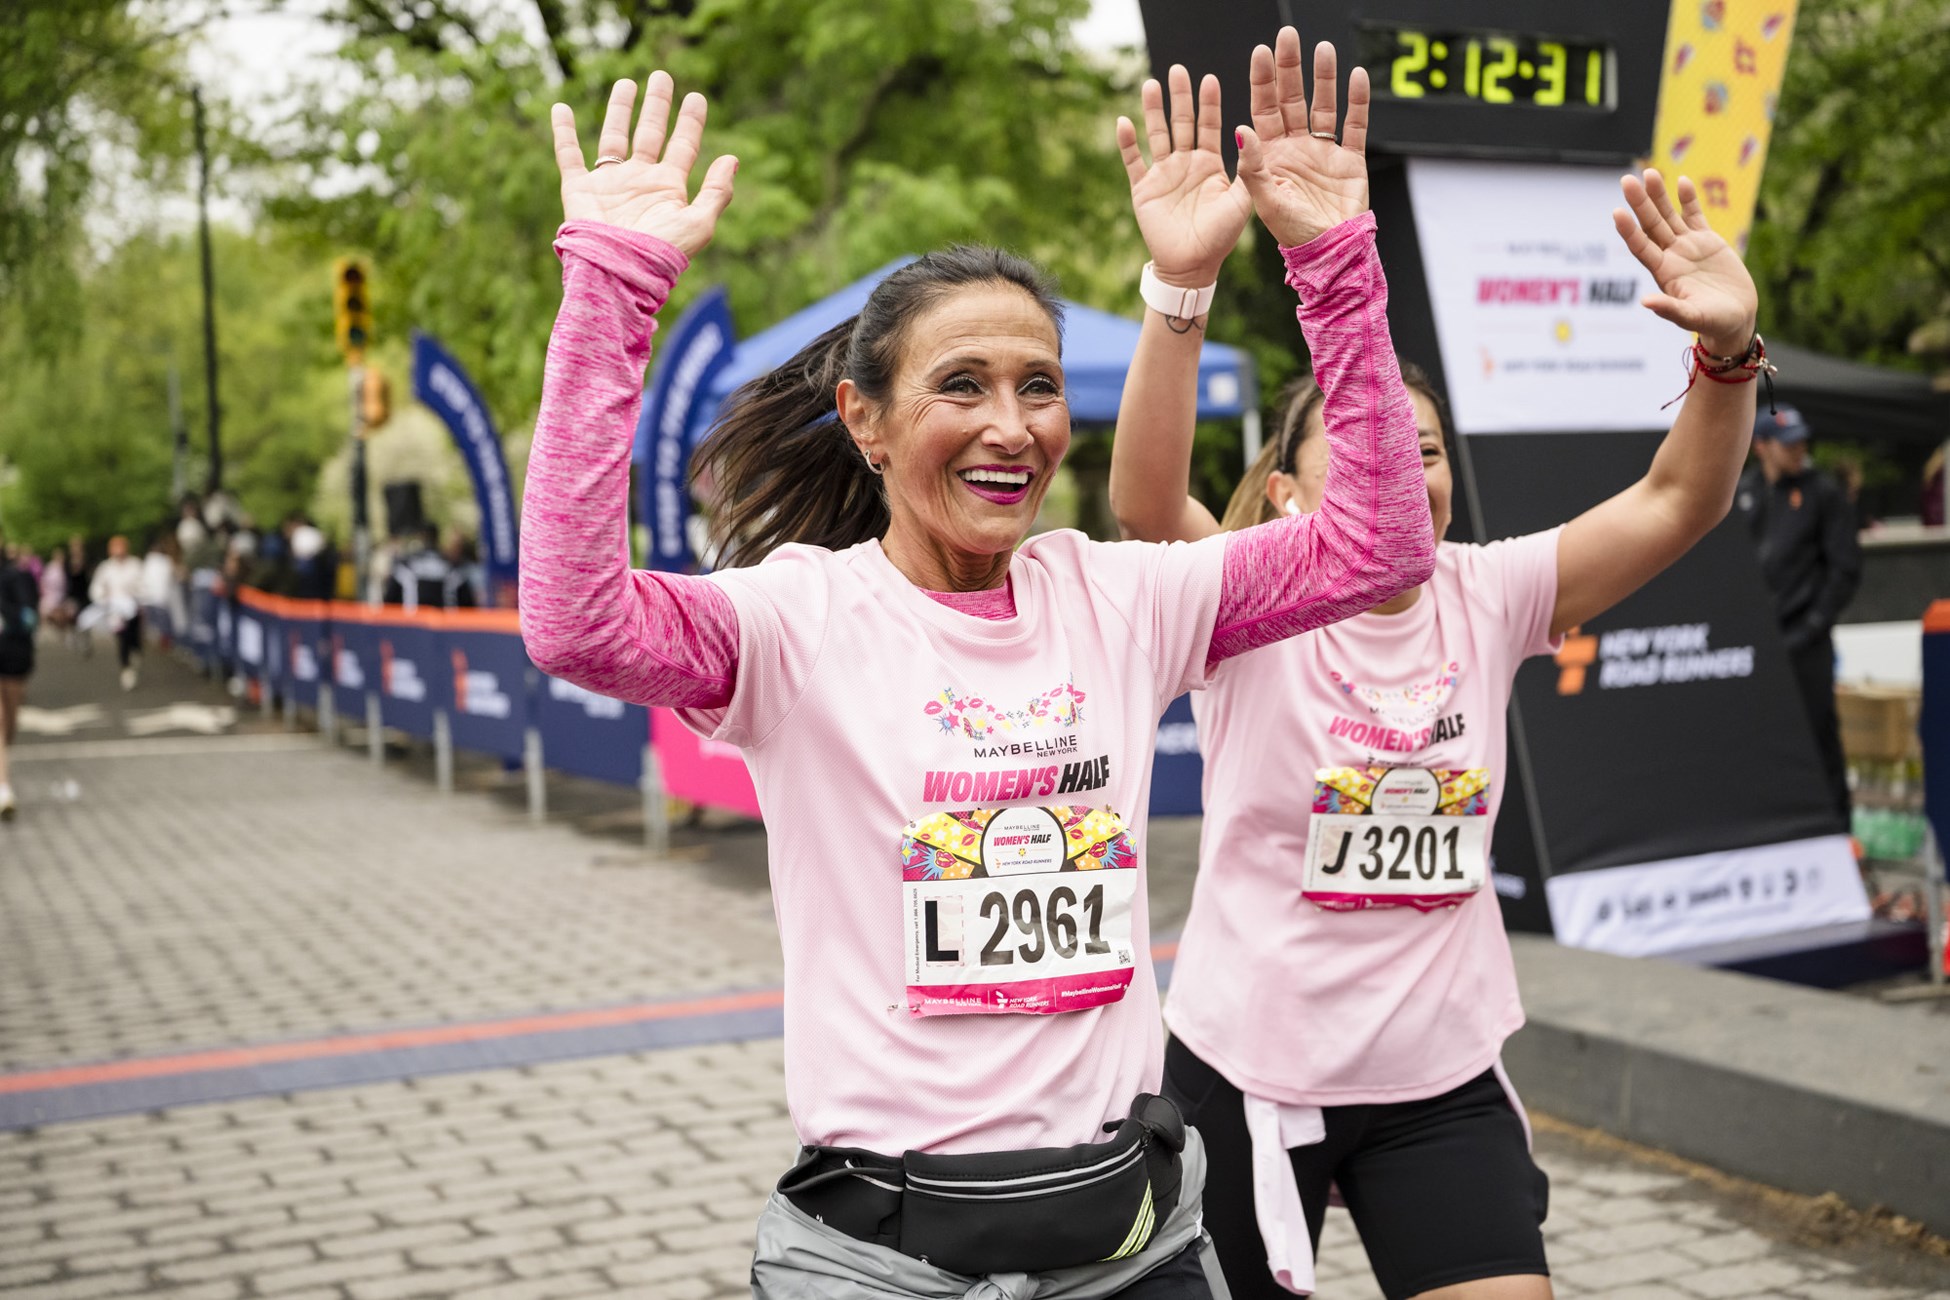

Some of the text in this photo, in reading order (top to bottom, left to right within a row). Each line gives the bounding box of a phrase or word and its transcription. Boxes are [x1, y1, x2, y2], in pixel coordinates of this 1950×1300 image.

[1598, 622, 1710, 659] NEW YORK
[1598, 653, 1660, 690] ROAD
[974, 734, 1078, 758] MAYBELLINE
[1036, 746, 1078, 758] NEW YORK
[922, 754, 1110, 803] WOMEN'S HALF
[1003, 823, 1041, 831] MAYBELLINE
[993, 833, 1052, 847] WOMEN'S HALF
[1321, 830, 1353, 875] J
[1358, 825, 1464, 880] 3201
[924, 883, 1112, 967] L 2961
[924, 997, 982, 1005] MAYBELLINE
[1025, 1000, 1050, 1008] RUNNERS
